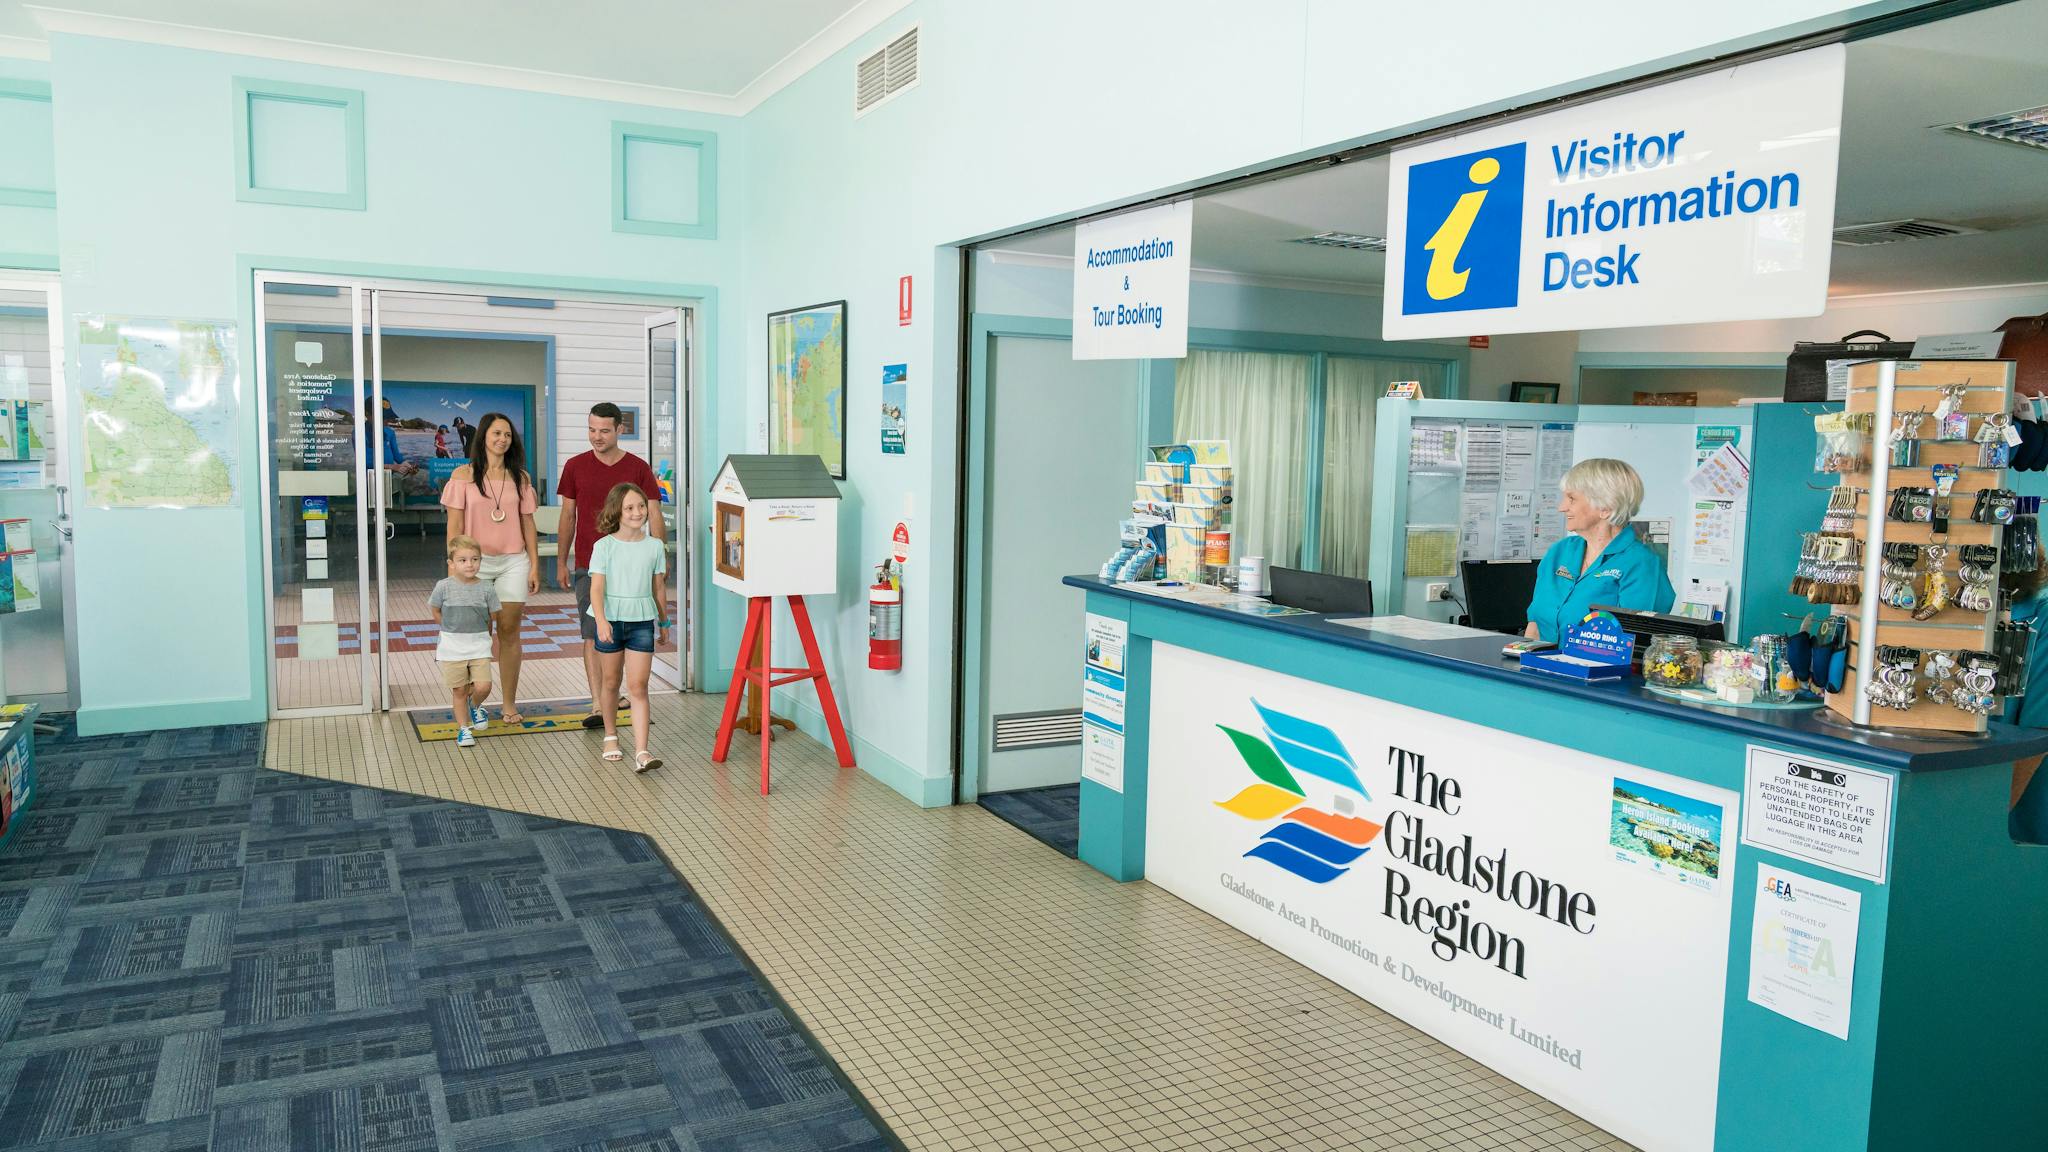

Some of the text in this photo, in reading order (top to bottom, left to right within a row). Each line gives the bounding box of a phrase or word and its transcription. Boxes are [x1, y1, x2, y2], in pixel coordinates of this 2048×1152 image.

[1551, 130, 1685, 184] Visitor
[1546, 170, 1799, 239] Information
[1087, 237, 1173, 268] Accommodation
[1124, 275, 1130, 291] &
[1543, 244, 1640, 292] Desk
[1093, 302, 1162, 329] Tour Booking
[1580, 630, 1617, 643] MOOD RING
[1388, 745, 1462, 816] The
[1760, 782, 1802, 798] PERSONAL
[1775, 776, 1860, 802] FOR THE SAFETY OF
[1622, 803, 1710, 838] Heron Island Bookings
[1761, 793, 1871, 826] ADVISABLE NOT TO LEAVE
[1767, 803, 1863, 833] UNATTENDED BAGS OR
[1633, 825, 1669, 845] Available
[1765, 812, 1863, 844] LUGGAGE IN THIS AREA
[1775, 829, 1814, 842] RESPONSIBILITY
[1820, 841, 1847, 853] ACCEPTED
[1812, 845, 1833, 855] DAMAGE
[1384, 810, 1597, 935] Gladstone
[1768, 876, 1791, 897] GEA
[1381, 867, 1528, 980] Region
[1780, 908, 1816, 926] CERTIFICATE
[1783, 925, 1822, 942] MEMBERSHIP
[1220, 872, 1583, 1070] Gladstone Area Promotion & Development Limited
